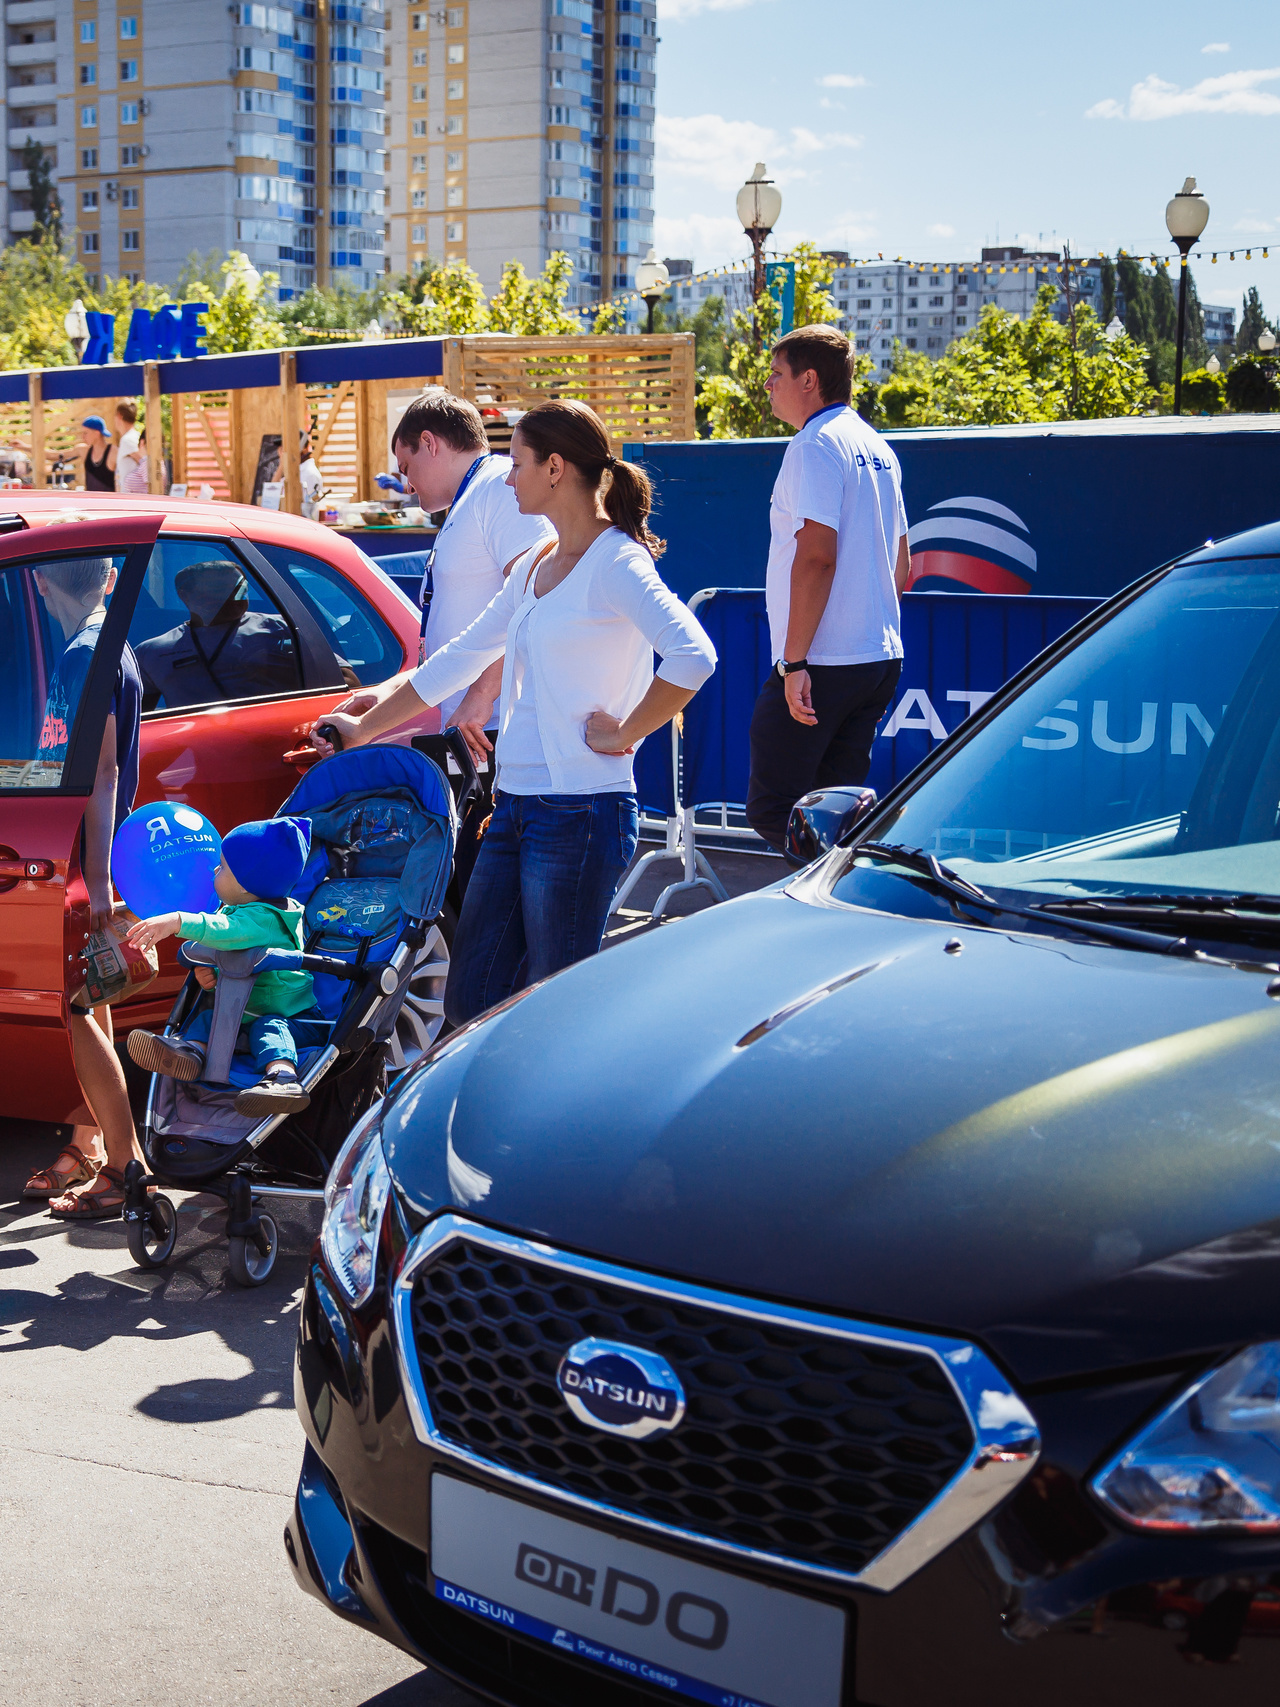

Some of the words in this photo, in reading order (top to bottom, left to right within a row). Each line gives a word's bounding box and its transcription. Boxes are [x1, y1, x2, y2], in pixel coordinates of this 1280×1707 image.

[880, 688, 1228, 755] ATSUN
[146, 816, 172, 843] Я
[151, 834, 214, 854] DATSUN
[565, 1369, 667, 1413] DATSUN
[443, 1585, 515, 1624] DATSUN
[608, 1653, 638, 1672] Авто
